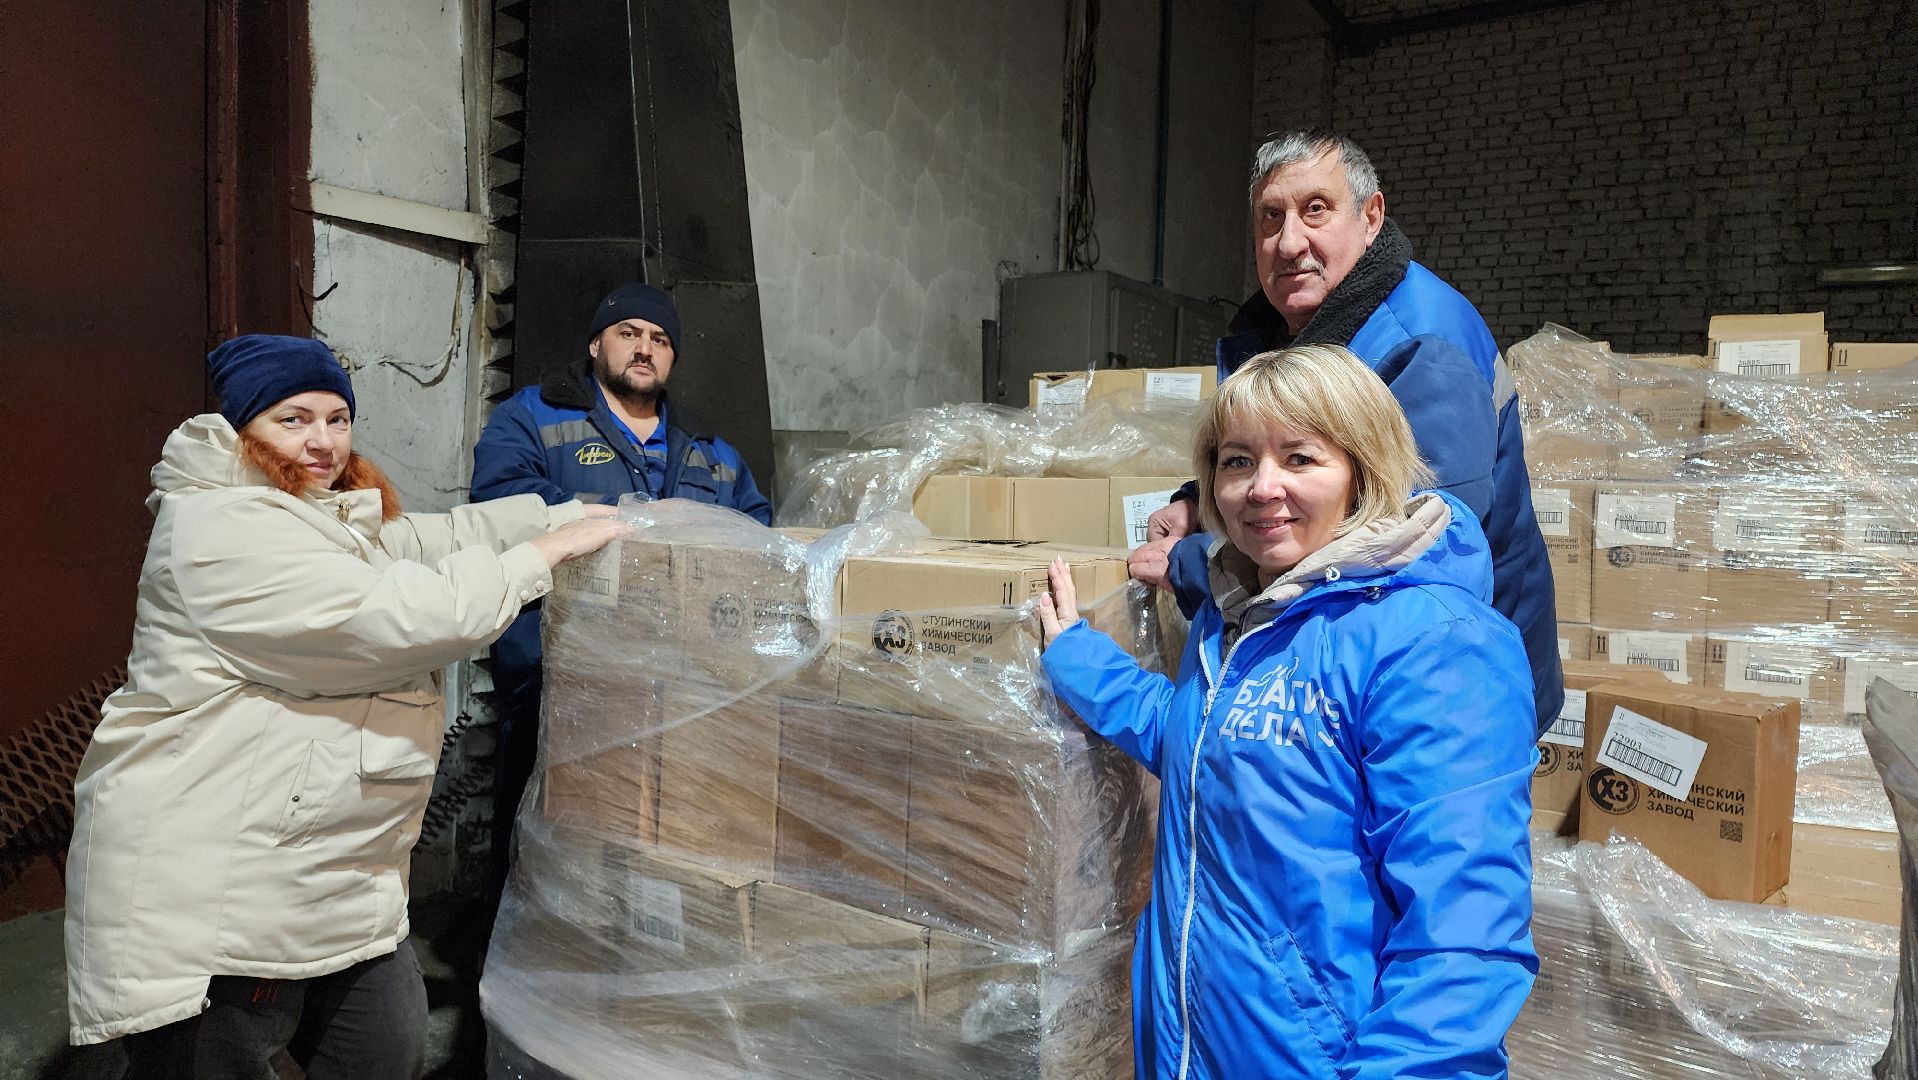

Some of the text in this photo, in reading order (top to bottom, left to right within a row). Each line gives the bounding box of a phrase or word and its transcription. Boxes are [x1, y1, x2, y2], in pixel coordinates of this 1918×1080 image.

[922, 615, 991, 631] СТУПИНСКИЙ
[921, 628, 993, 645] ХИМИЧЕСКИЙ
[921, 642, 956, 656] ЗАВОД
[1219, 707, 1311, 751] ДЕЛА
[1610, 731, 1642, 751] 22903
[1647, 801, 1695, 822] ЗАВОД
